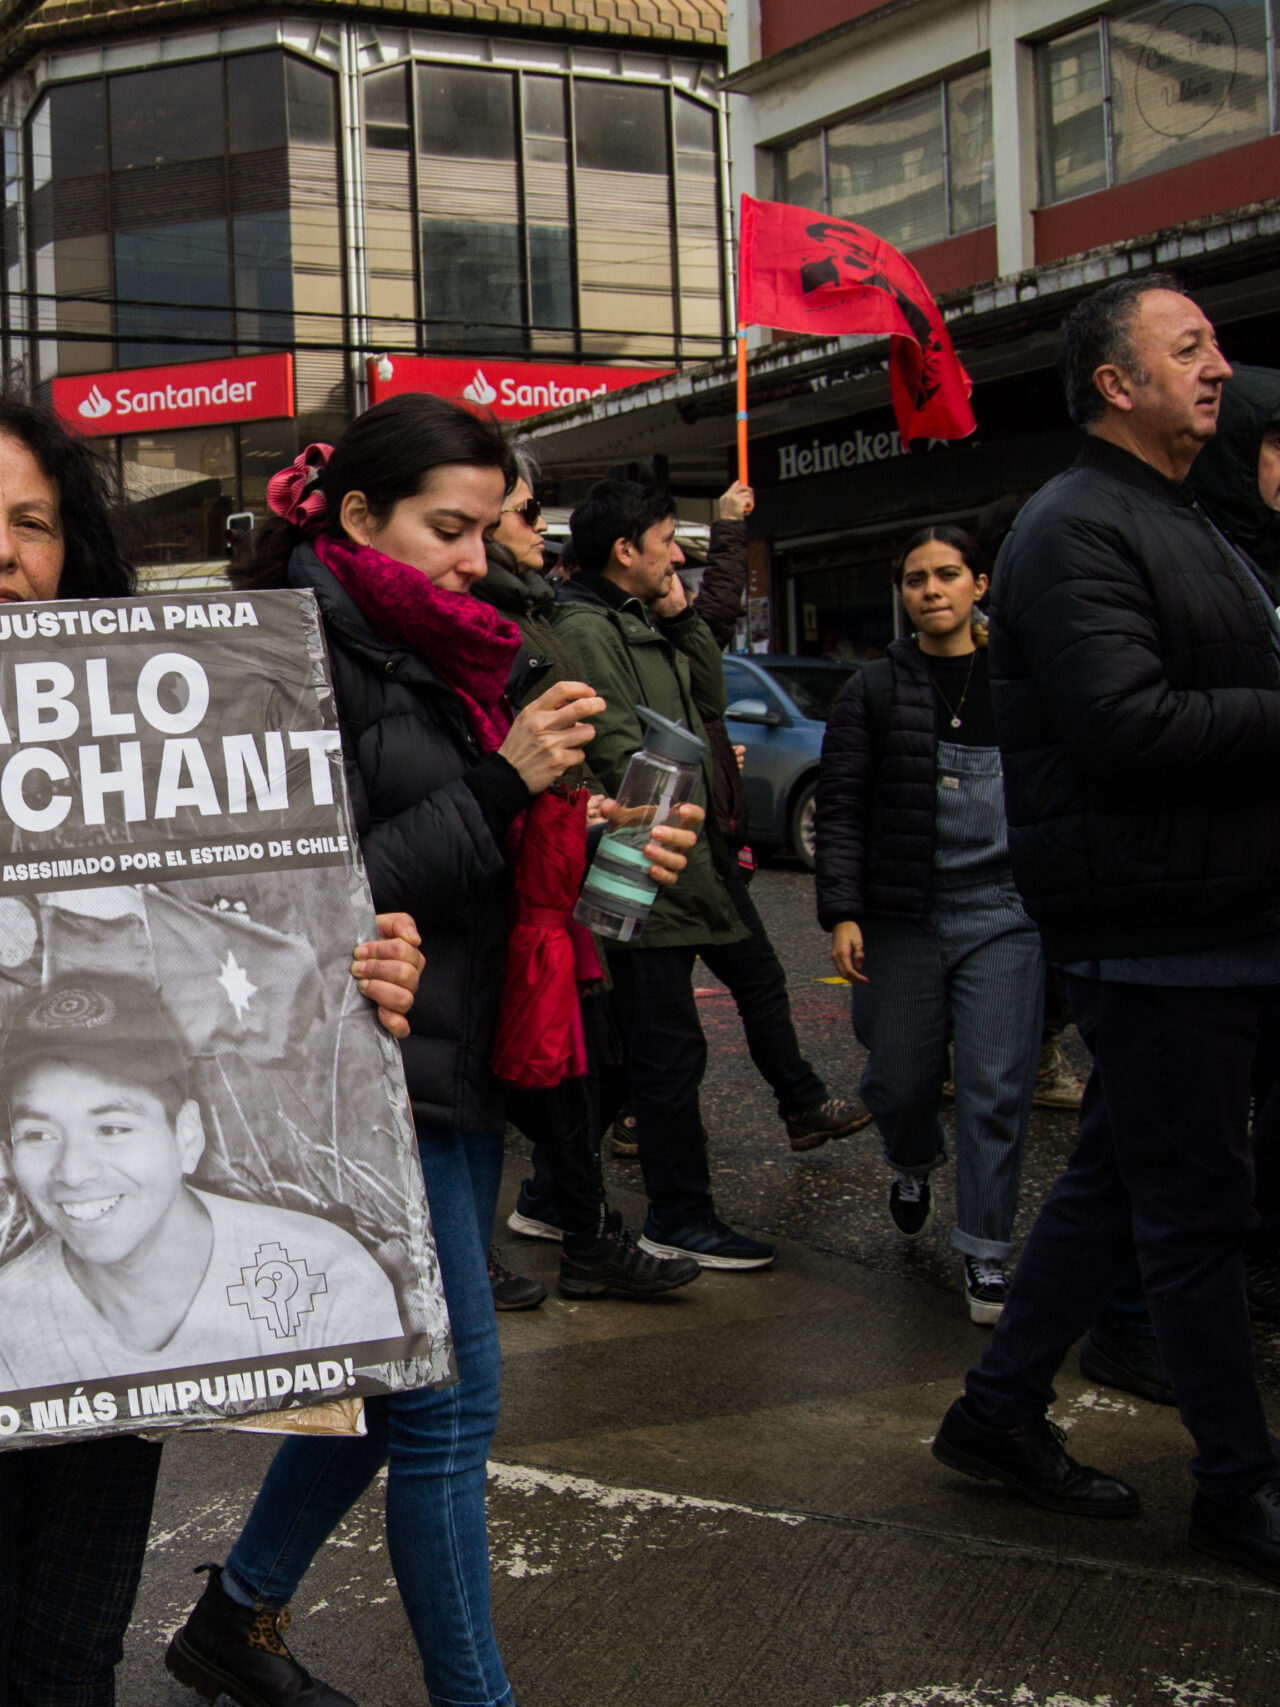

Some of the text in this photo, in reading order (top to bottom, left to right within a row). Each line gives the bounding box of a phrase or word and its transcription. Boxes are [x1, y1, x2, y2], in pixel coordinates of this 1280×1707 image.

[116, 378, 257, 415] Santander
[163, 602, 259, 630] PARA
[3, 856, 116, 881] ASESINADO
[120, 852, 162, 871] POR
[165, 850, 187, 868] EL
[190, 843, 264, 865] ESTADO
[268, 840, 293, 858] DE
[296, 835, 349, 855] CHILE
[30, 1387, 118, 1432] MÁS
[128, 1358, 357, 1417] IMPUNIDAD!
